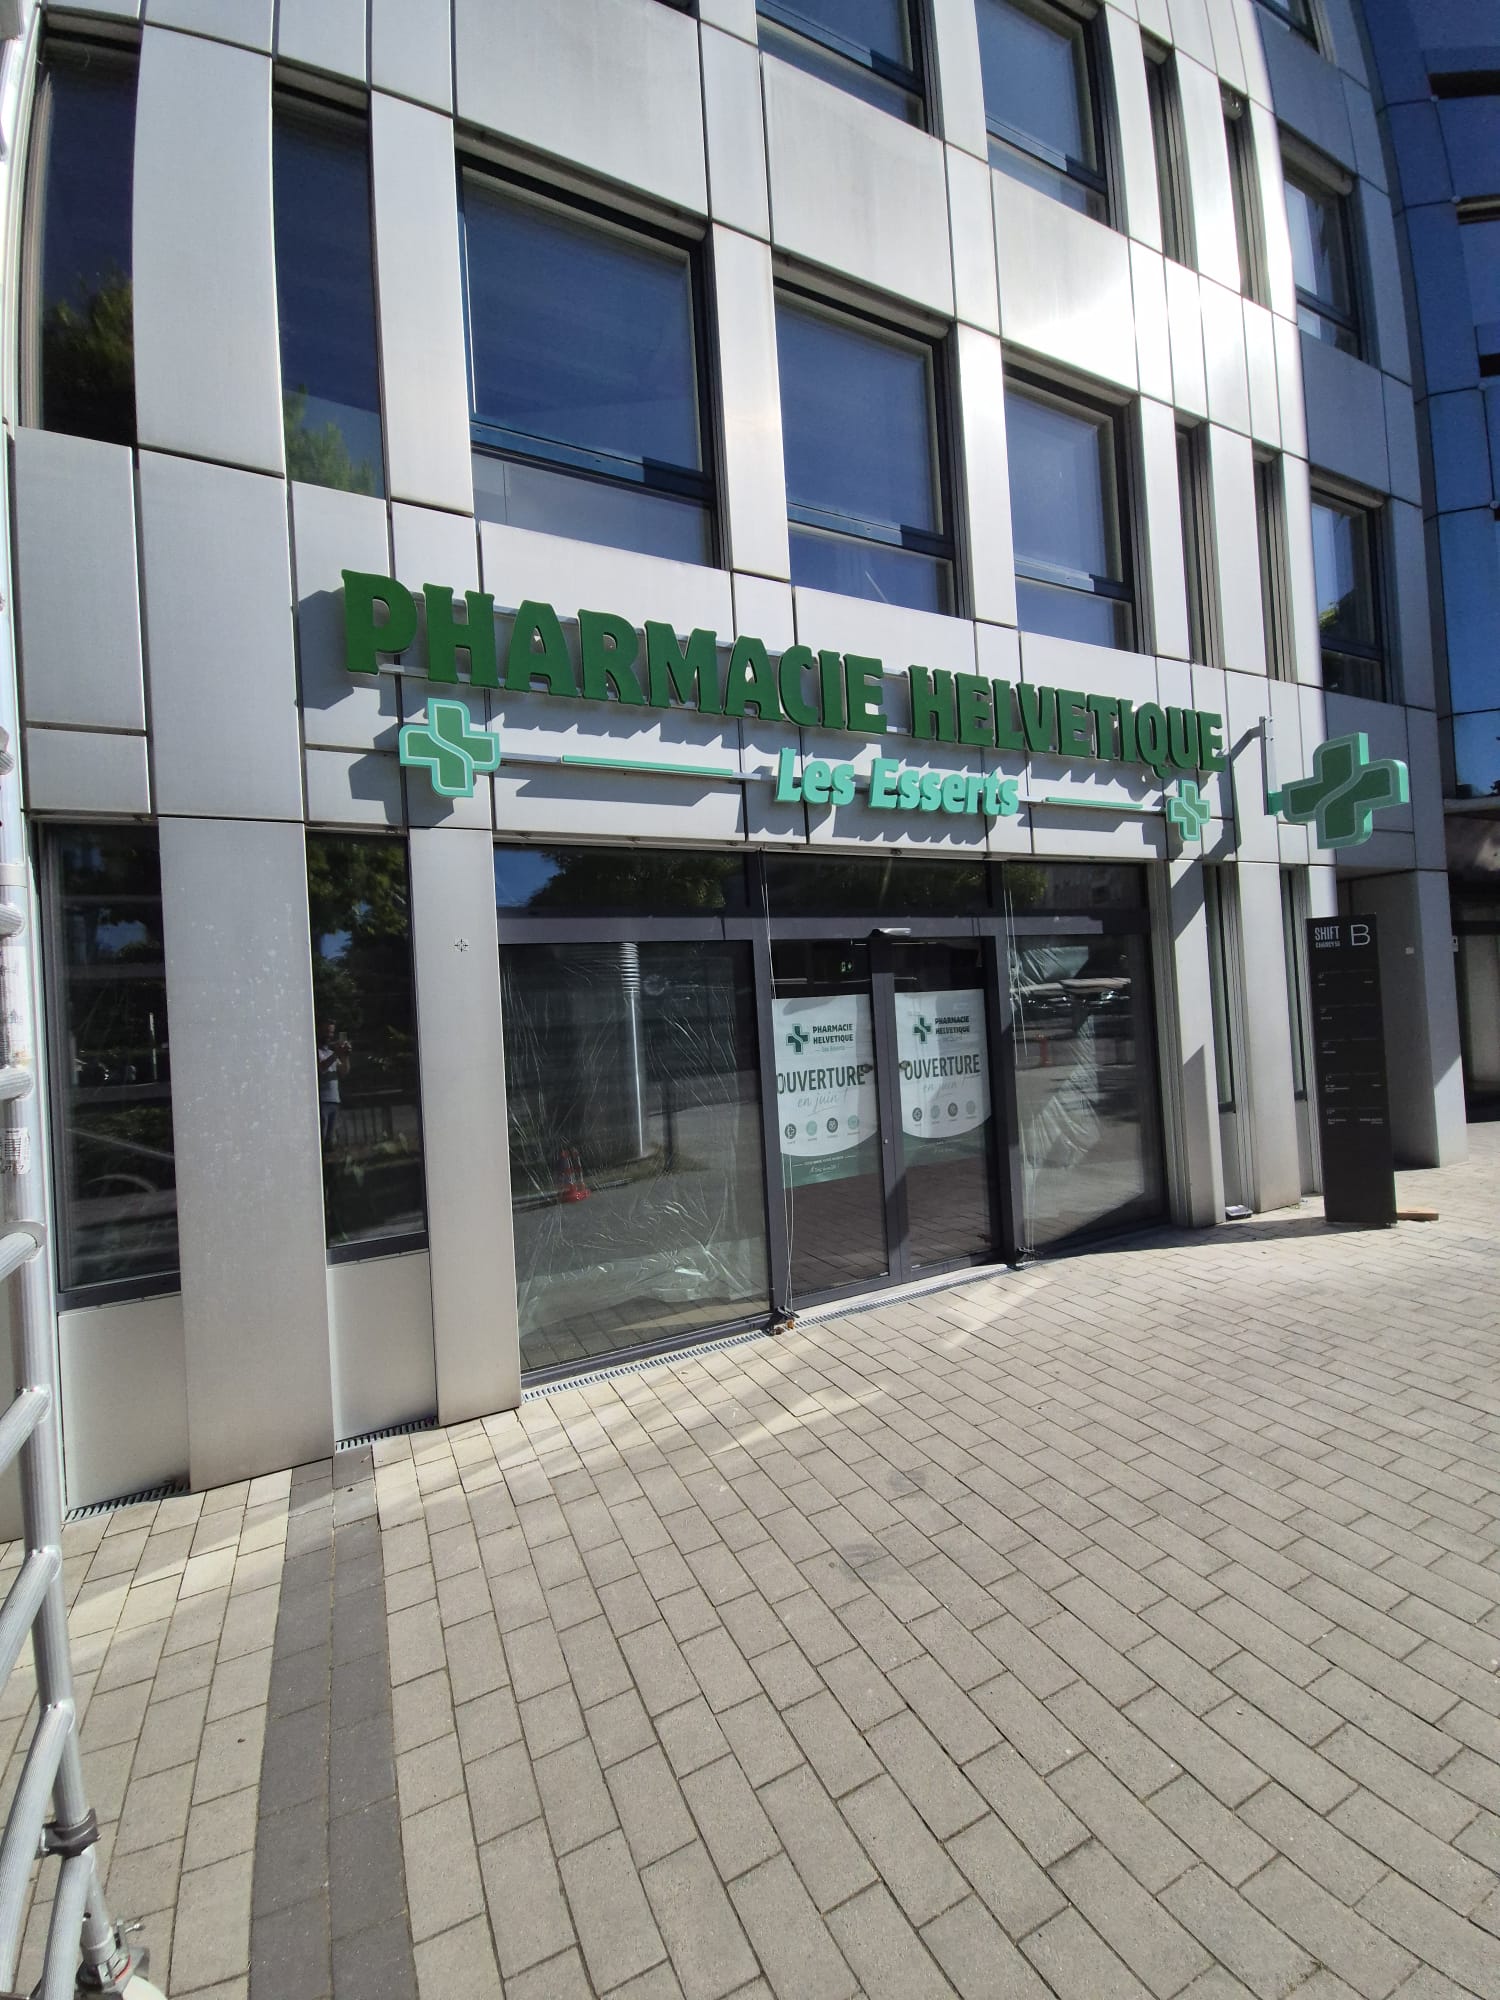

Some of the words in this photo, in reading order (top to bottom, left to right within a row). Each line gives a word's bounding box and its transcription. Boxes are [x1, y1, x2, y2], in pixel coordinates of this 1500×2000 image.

[341, 568, 888, 735] PHARMACIE
[907, 665, 1226, 779] HELVETIQUE
[775, 747, 855, 806] Les
[868, 757, 1019, 817] Esserts
[1314, 925, 1340, 941] SHIFT
[1351, 924, 1370, 946] B
[812, 1024, 854, 1033] PHARMACIE
[935, 1015, 970, 1025] PHARMACIE
[813, 1033, 854, 1045] HELVETIQUE
[904, 1055, 981, 1080] OUVERTURE
[776, 1065, 866, 1094] OUVERTURE
